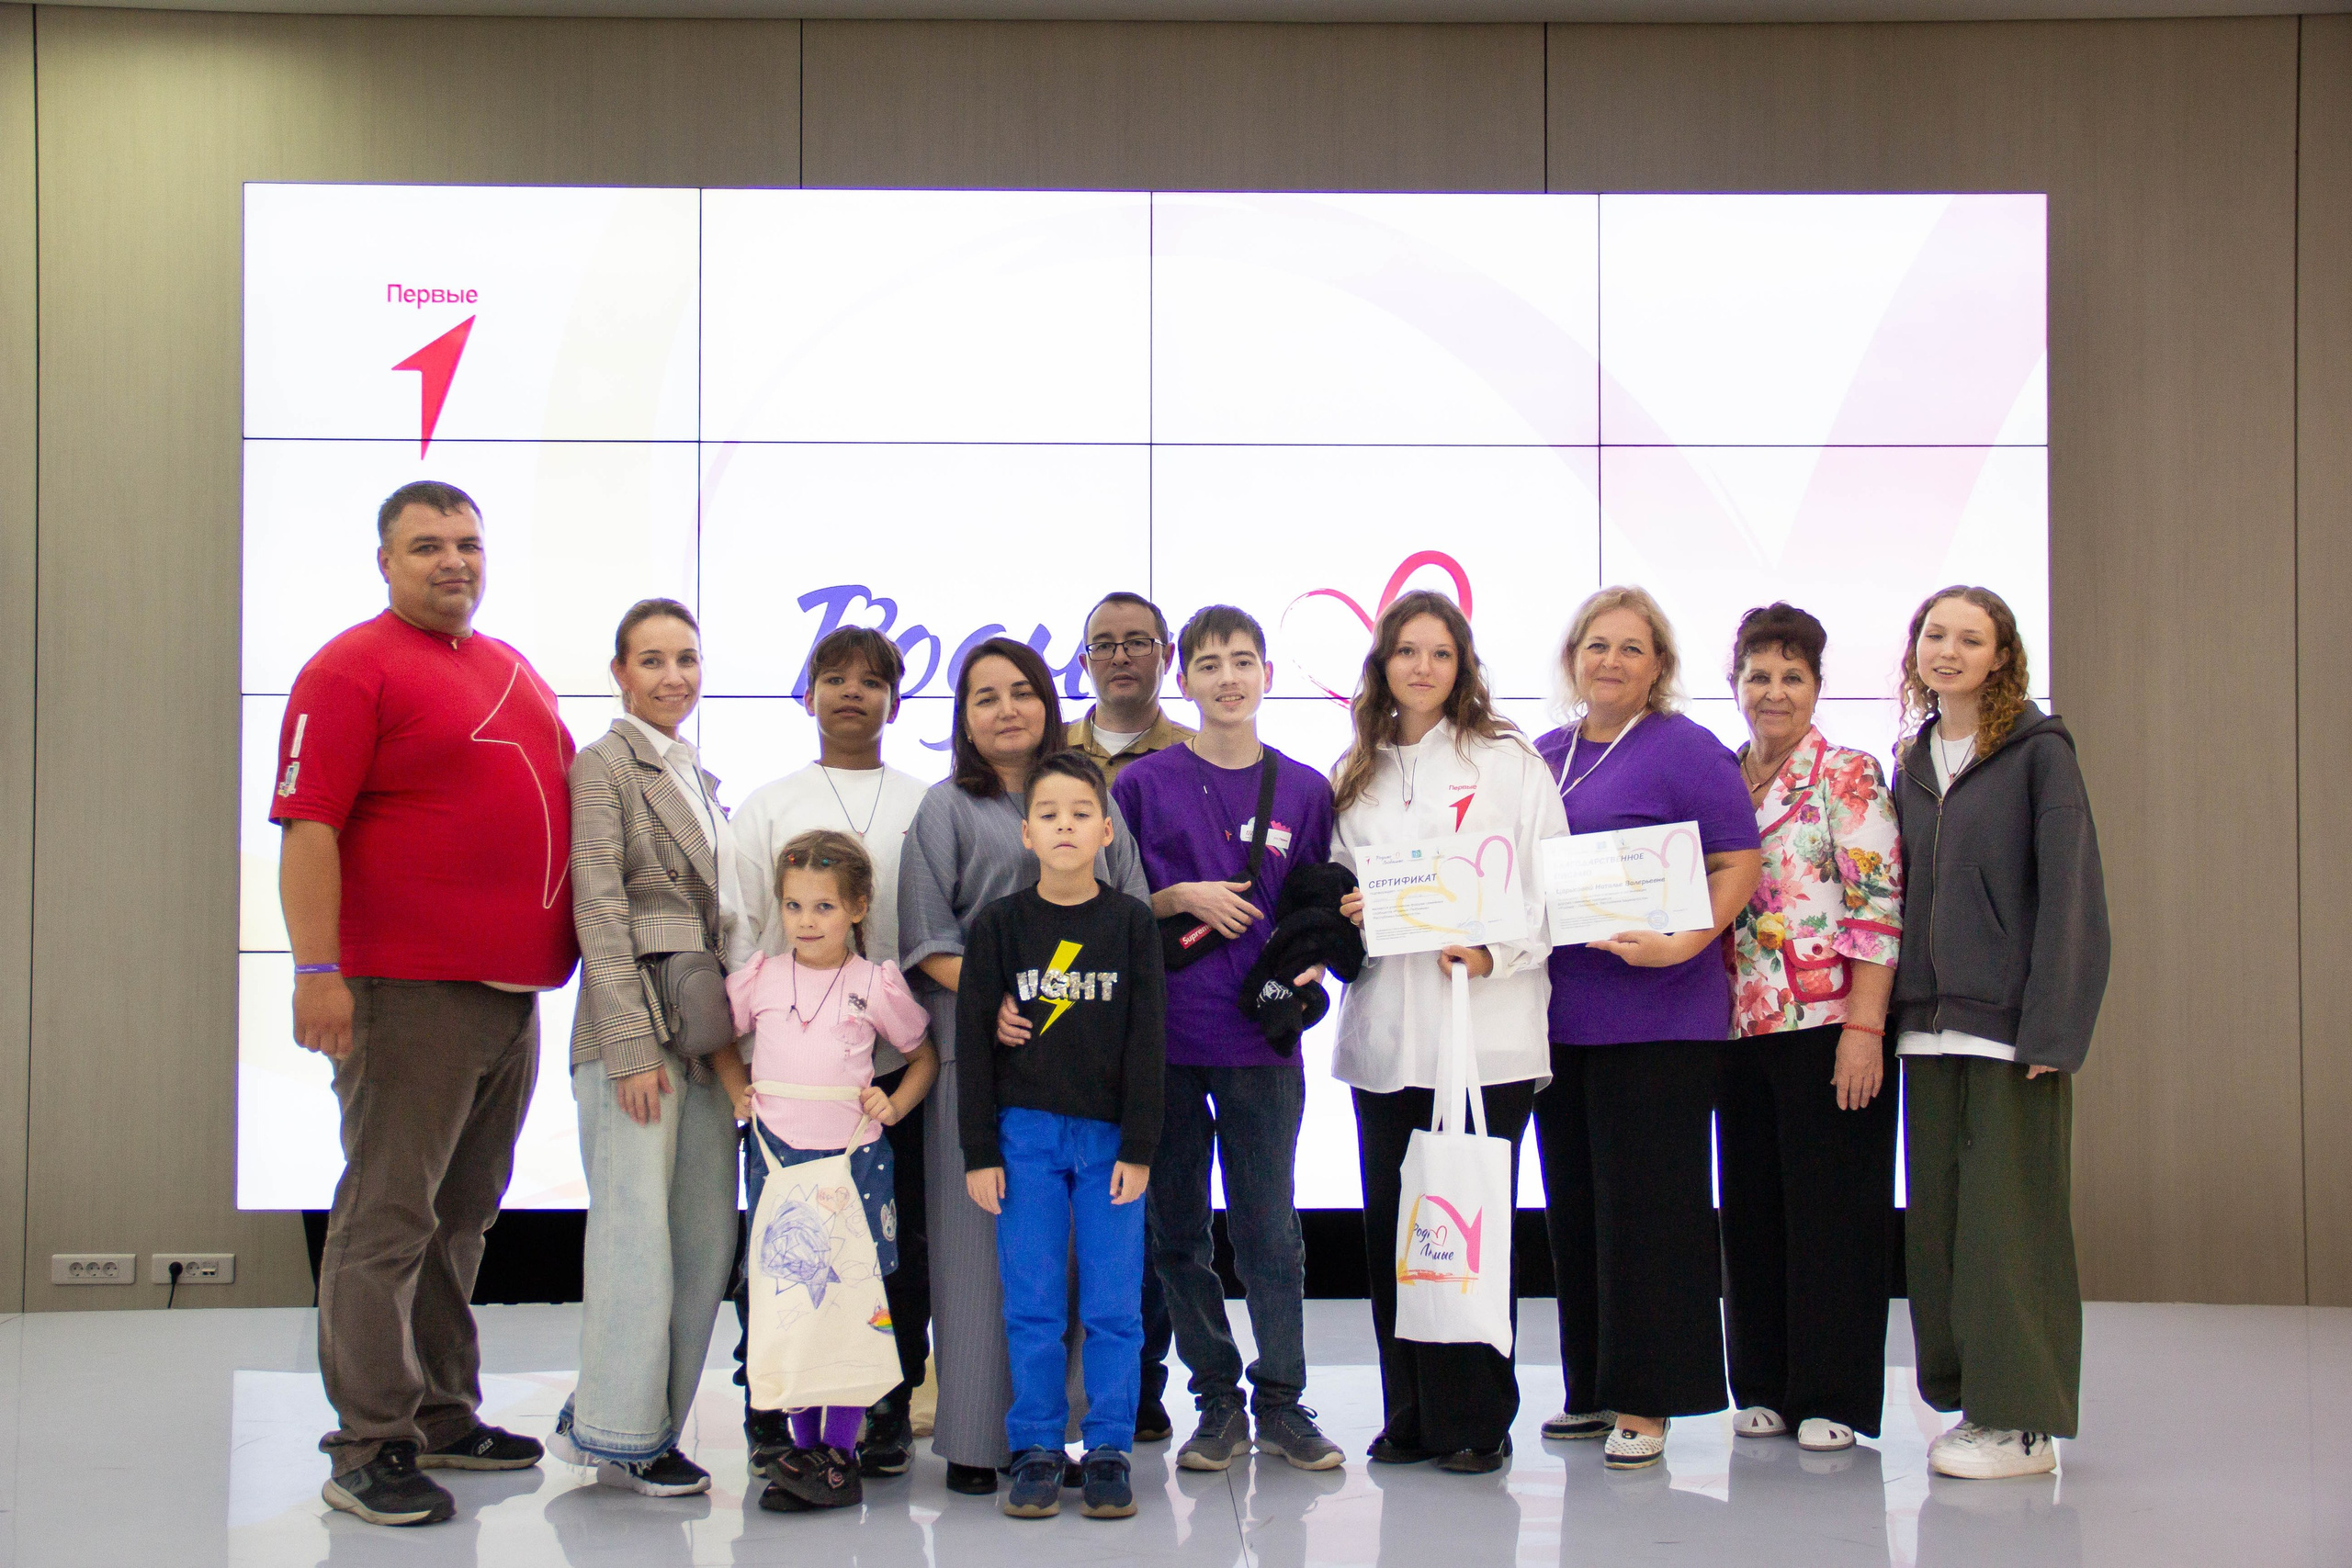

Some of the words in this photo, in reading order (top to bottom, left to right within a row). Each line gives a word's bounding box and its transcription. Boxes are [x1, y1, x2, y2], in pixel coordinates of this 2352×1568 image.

[387, 284, 479, 310] Первые
[1368, 873, 1438, 889] СЕРТИФИКАТ
[1625, 876, 1666, 887] Валерьевне
[1182, 924, 1211, 945] Suprem
